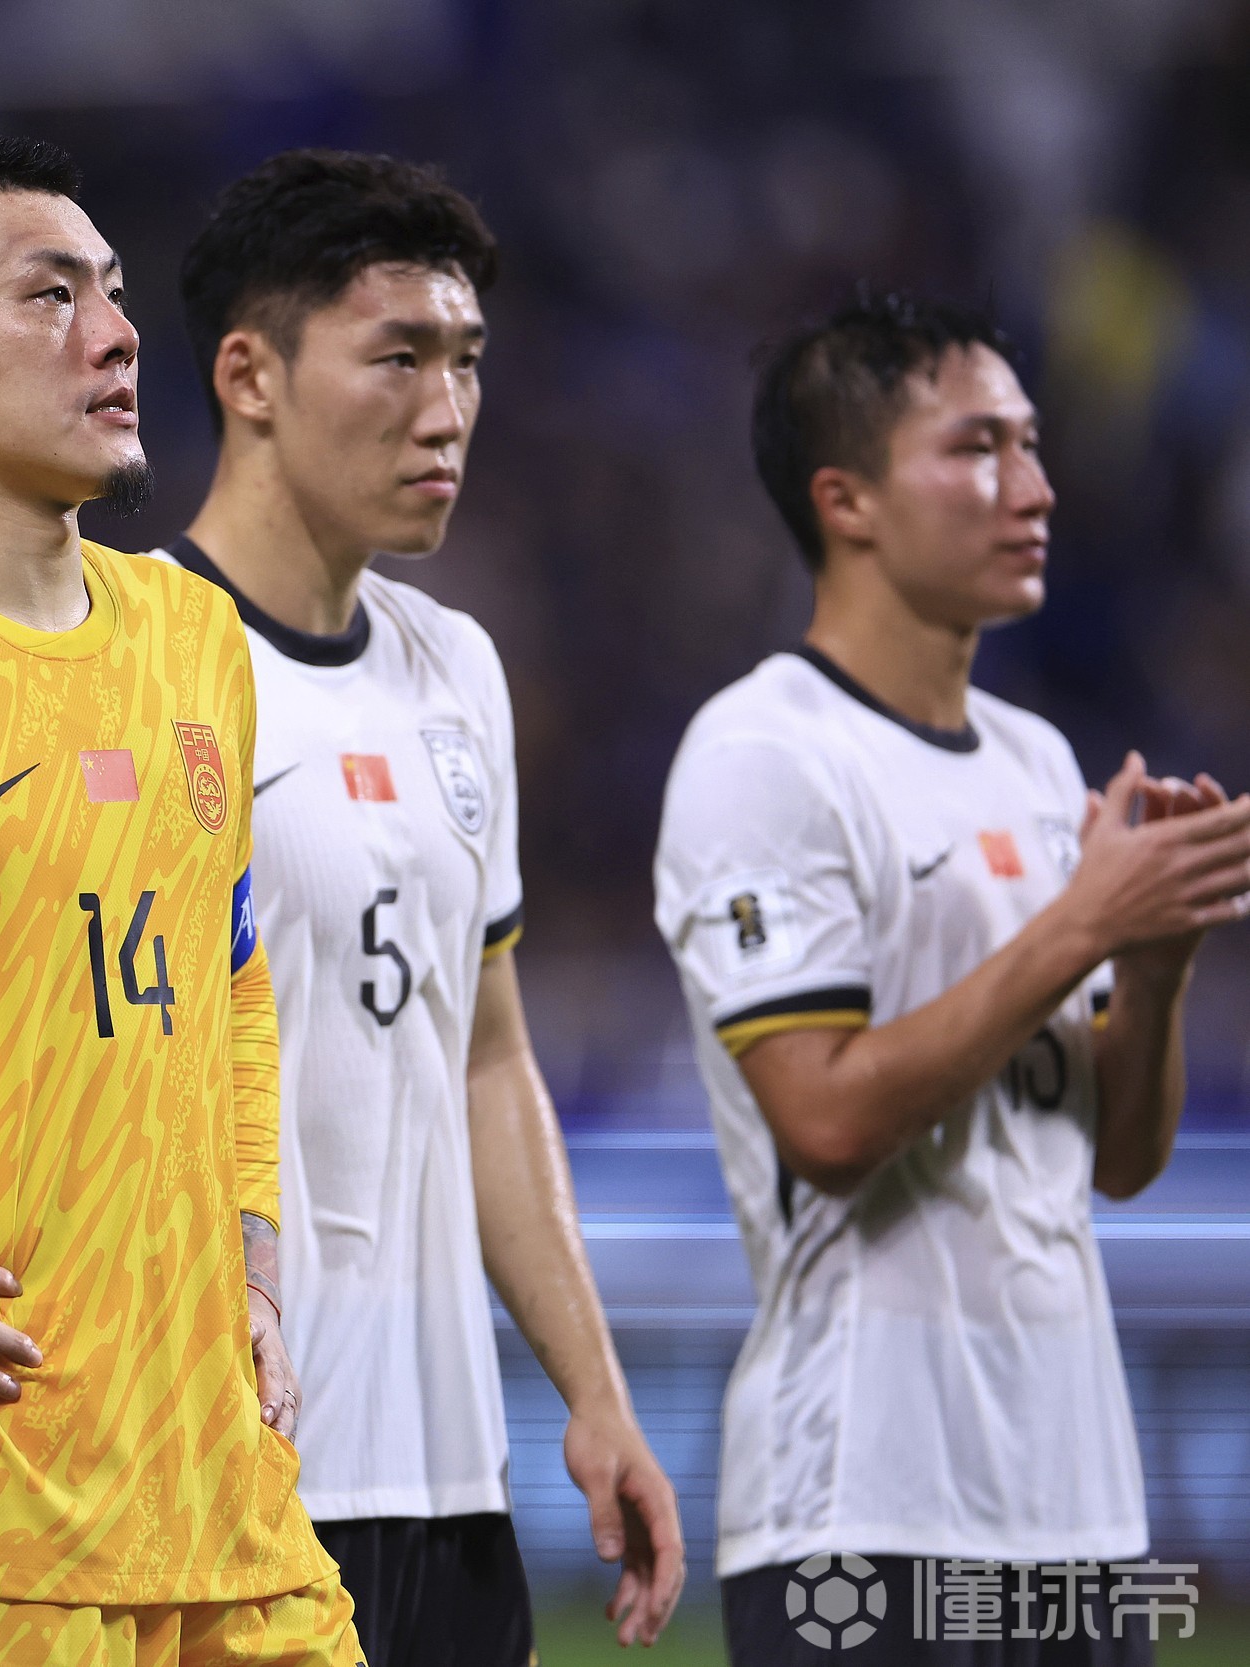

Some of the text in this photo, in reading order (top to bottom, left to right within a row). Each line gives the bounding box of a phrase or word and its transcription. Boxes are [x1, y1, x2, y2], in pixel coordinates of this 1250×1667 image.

[179, 726, 216, 748] CFA
[78, 890, 176, 1039] 14
[359, 887, 413, 1027] 5
